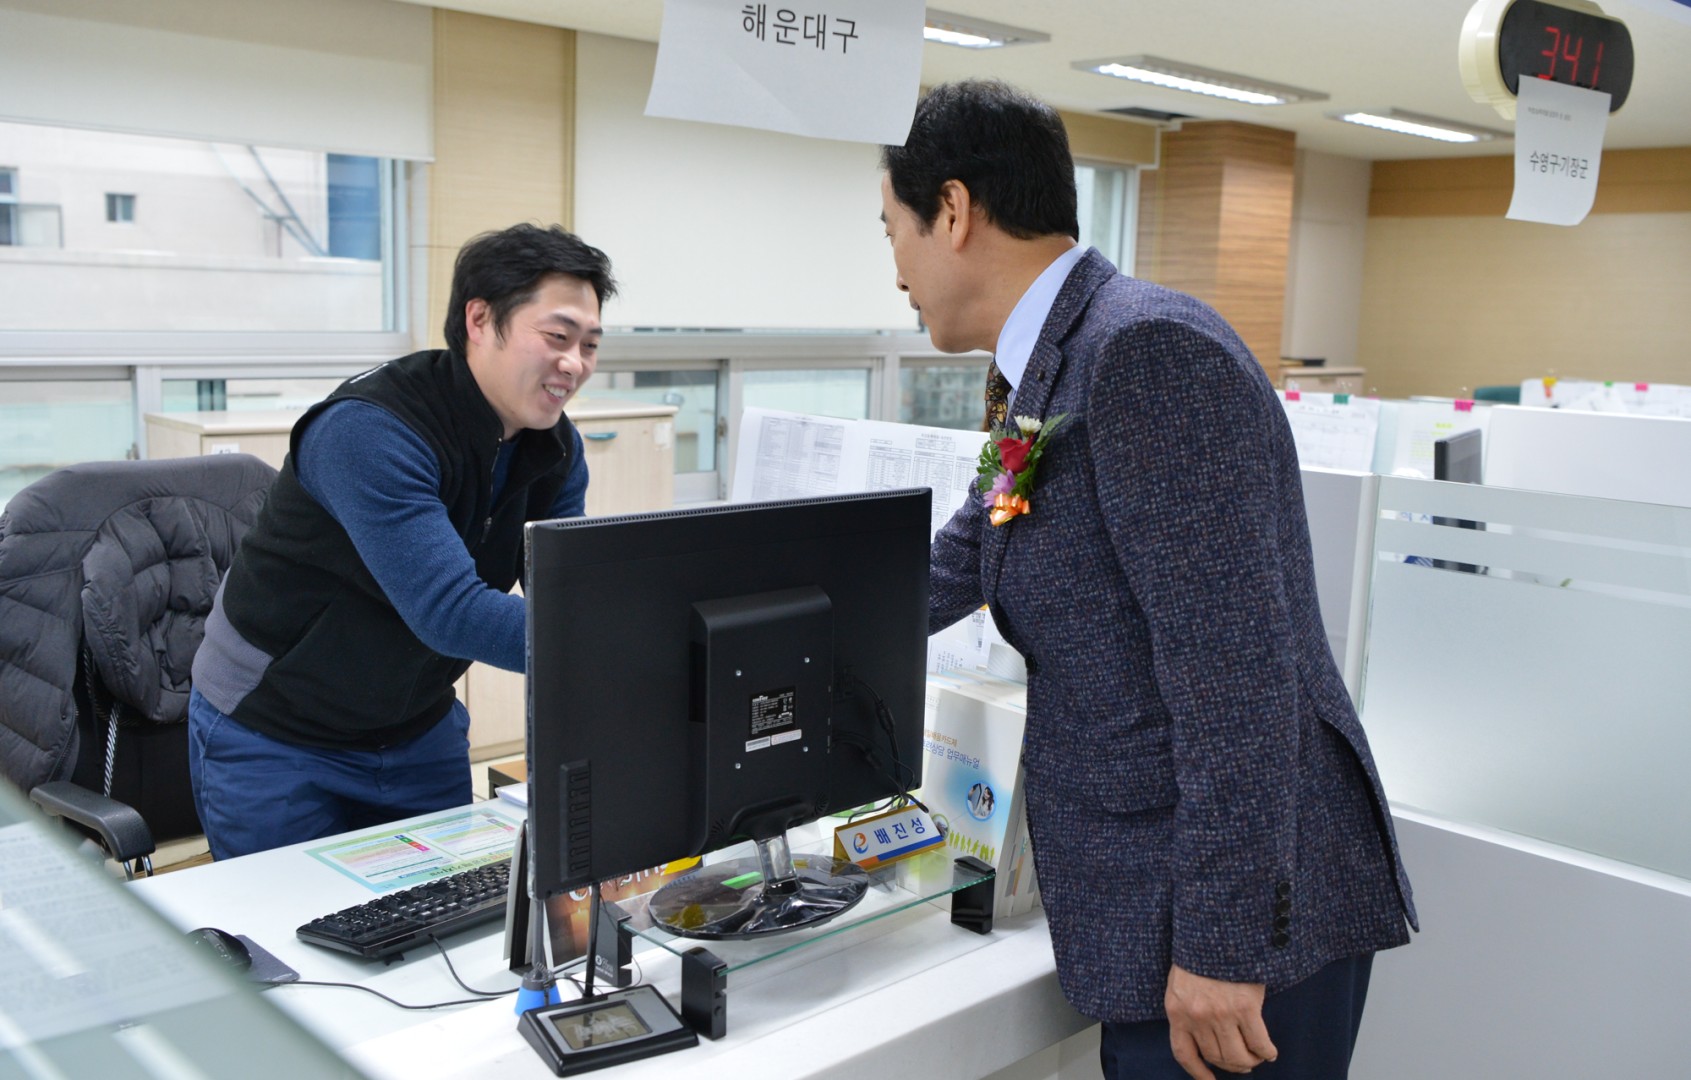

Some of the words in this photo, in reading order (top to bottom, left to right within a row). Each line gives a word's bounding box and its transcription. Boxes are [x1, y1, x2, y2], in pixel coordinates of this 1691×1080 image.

[742, 4, 859, 54] 해운대구
[1537, 26, 1604, 89] 341
[1529, 150, 1589, 180] 수영구기장군
